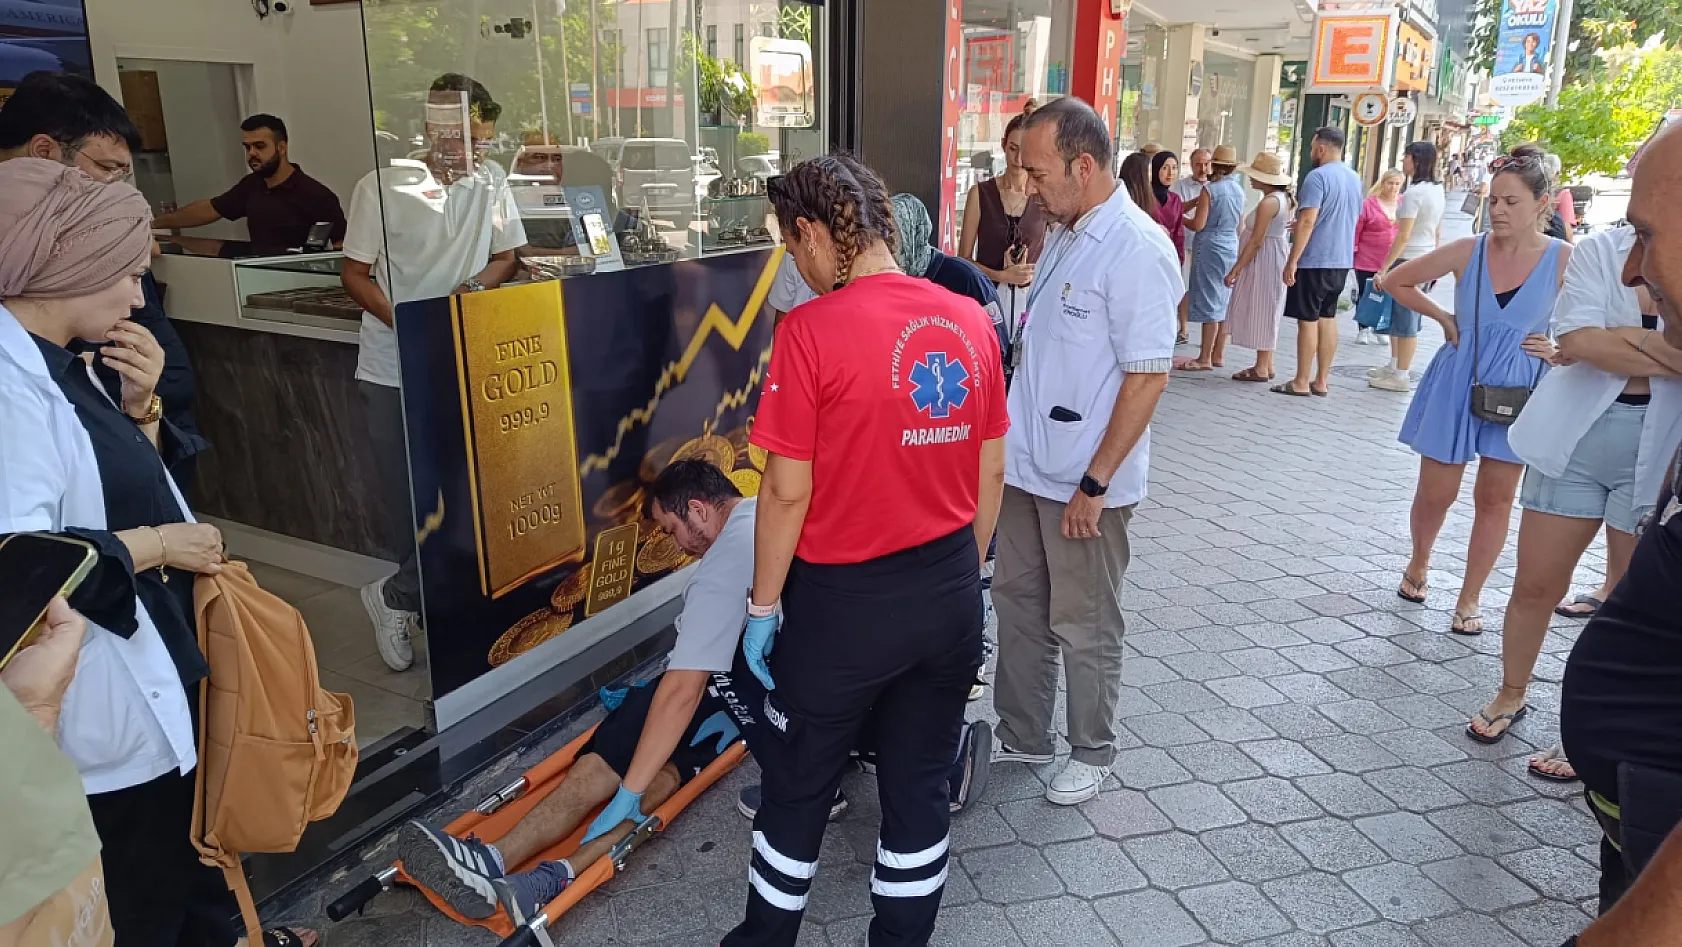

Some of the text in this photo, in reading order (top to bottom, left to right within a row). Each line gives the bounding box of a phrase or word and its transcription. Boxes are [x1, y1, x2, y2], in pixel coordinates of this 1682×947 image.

[1507, 13, 1547, 28] OKULU
[1328, 26, 1374, 75] E
[494, 334, 543, 363] FINE
[890, 338, 906, 389] FETHİYE
[901, 316, 930, 342] SAĞLIK
[930, 314, 978, 360] HİZMETLERİ
[481, 360, 557, 403] GOLD
[901, 421, 972, 447] PARAMEDİK
[509, 481, 556, 513] NET WT
[506, 503, 562, 541] 1000g
[608, 540, 625, 556] 1g
[601, 554, 627, 573] FINE
[596, 569, 627, 588] GOLD
